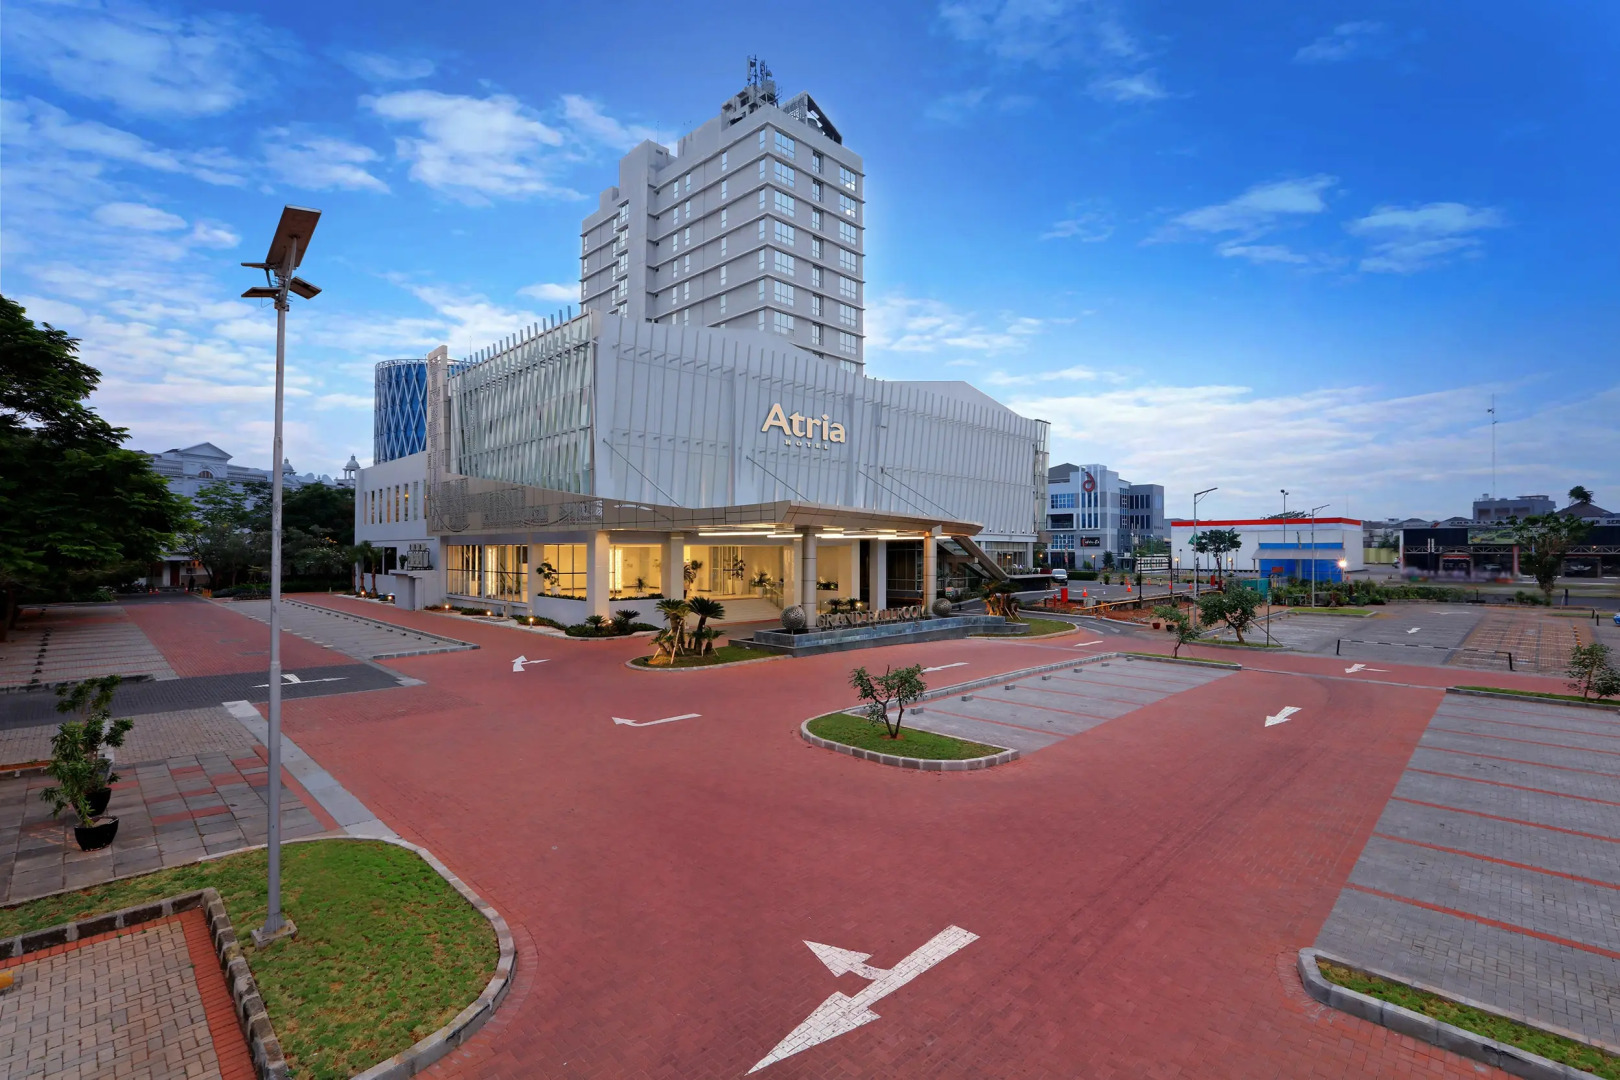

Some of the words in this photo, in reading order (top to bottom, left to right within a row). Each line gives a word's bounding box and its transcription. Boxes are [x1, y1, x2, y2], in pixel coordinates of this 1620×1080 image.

[761, 403, 846, 443] Atria
[784, 439, 829, 450] HOTEL
[816, 610, 864, 628] GRAND
[866, 605, 927, 623] BALLROOM
